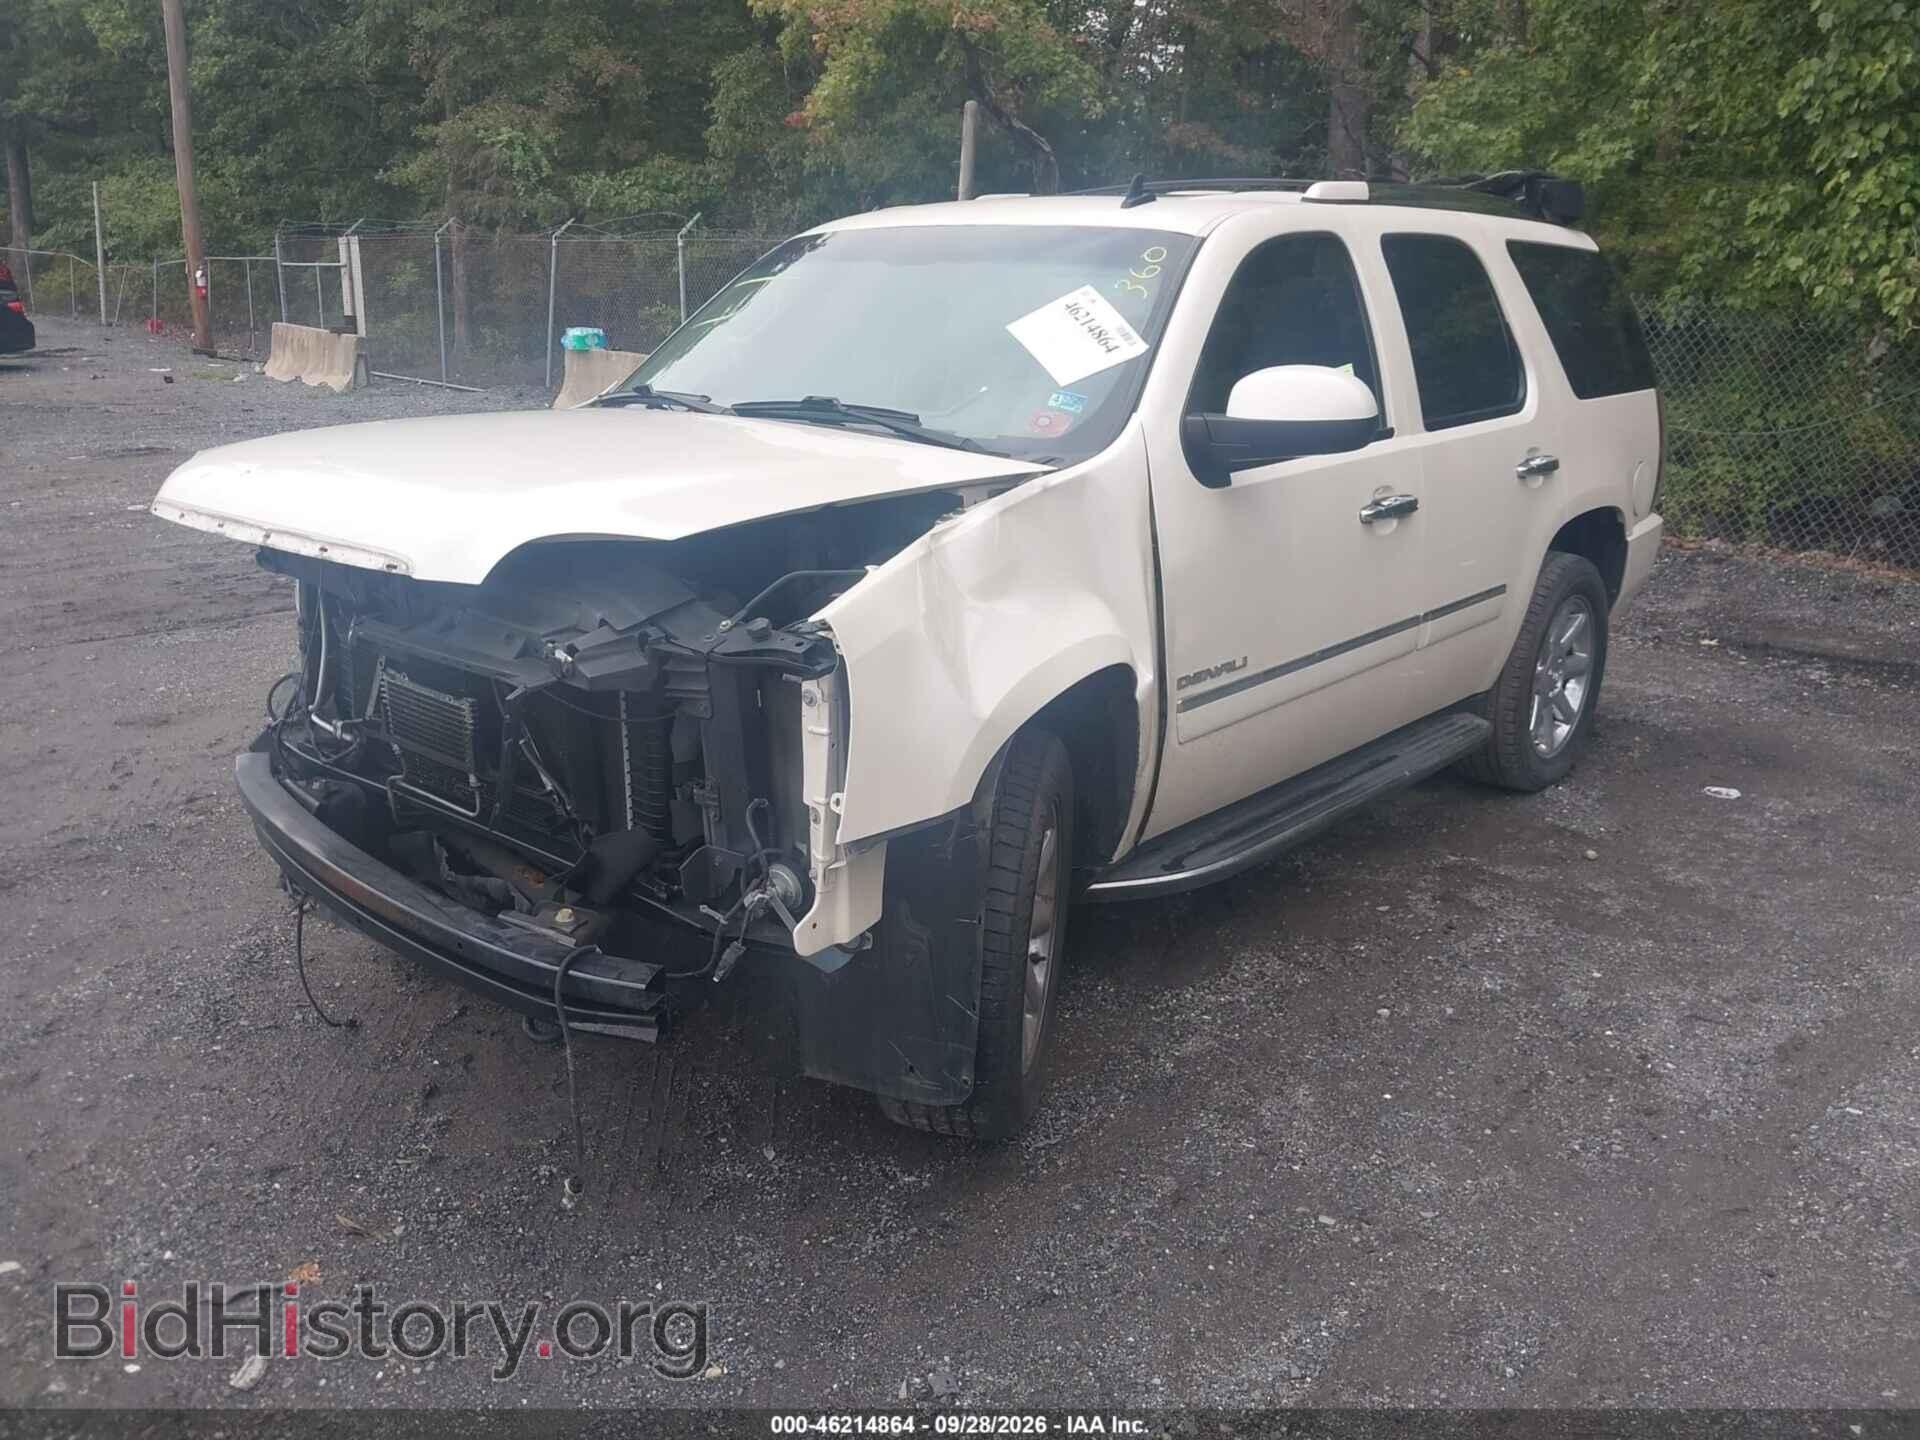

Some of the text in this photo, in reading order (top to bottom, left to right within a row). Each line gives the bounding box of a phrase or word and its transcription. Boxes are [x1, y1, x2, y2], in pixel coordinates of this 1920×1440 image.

[1114, 246, 1167, 299] 360
[1064, 302, 1120, 354] 46214864
[1176, 656, 1248, 691] DENALI
